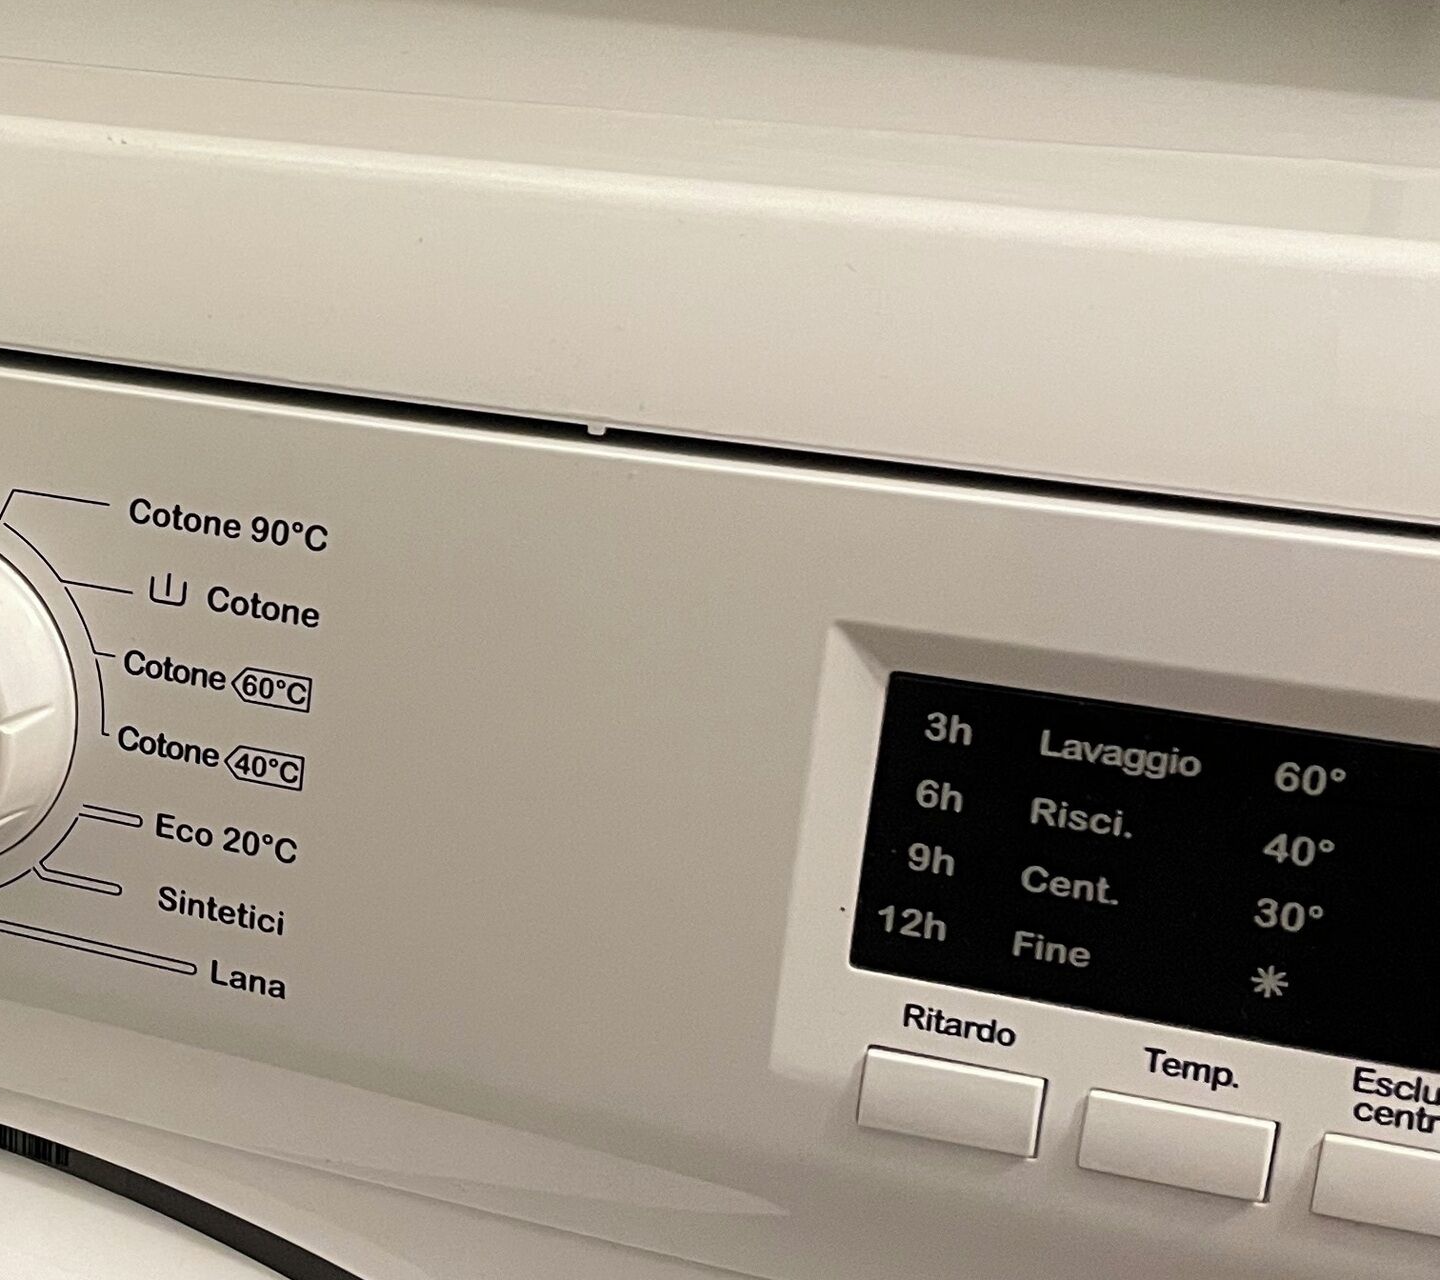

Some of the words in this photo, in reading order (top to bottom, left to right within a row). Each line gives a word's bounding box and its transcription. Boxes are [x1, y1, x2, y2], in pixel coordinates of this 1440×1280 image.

[128, 497, 242, 539] Cotone
[250, 515, 329, 552] 90°C
[206, 585, 321, 628] Cotone
[123, 649, 226, 691] Cotone
[241, 674, 307, 706] 60°C
[924, 711, 973, 746] 3h
[117, 725, 219, 768] Cotone
[233, 753, 300, 784] 40°C
[1039, 728, 1202, 780] Lavaggio
[915, 778, 964, 813] 6h
[1273, 760, 1347, 797] 60°
[155, 812, 213, 847] Eco
[222, 826, 298, 864] 20°C
[1029, 796, 1133, 839] Risci.
[906, 842, 956, 877] 9h
[1262, 832, 1336, 868] 40°
[1019, 864, 1119, 906] Cent.
[157, 886, 285, 936] Sintetici
[877, 904, 948, 942] 12h
[1253, 896, 1324, 933] 30°
[1011, 929, 1092, 969] Fine
[210, 959, 287, 1000] Lana
[902, 1002, 1017, 1048] Ritardo
[1144, 1046, 1240, 1092] Temp.
